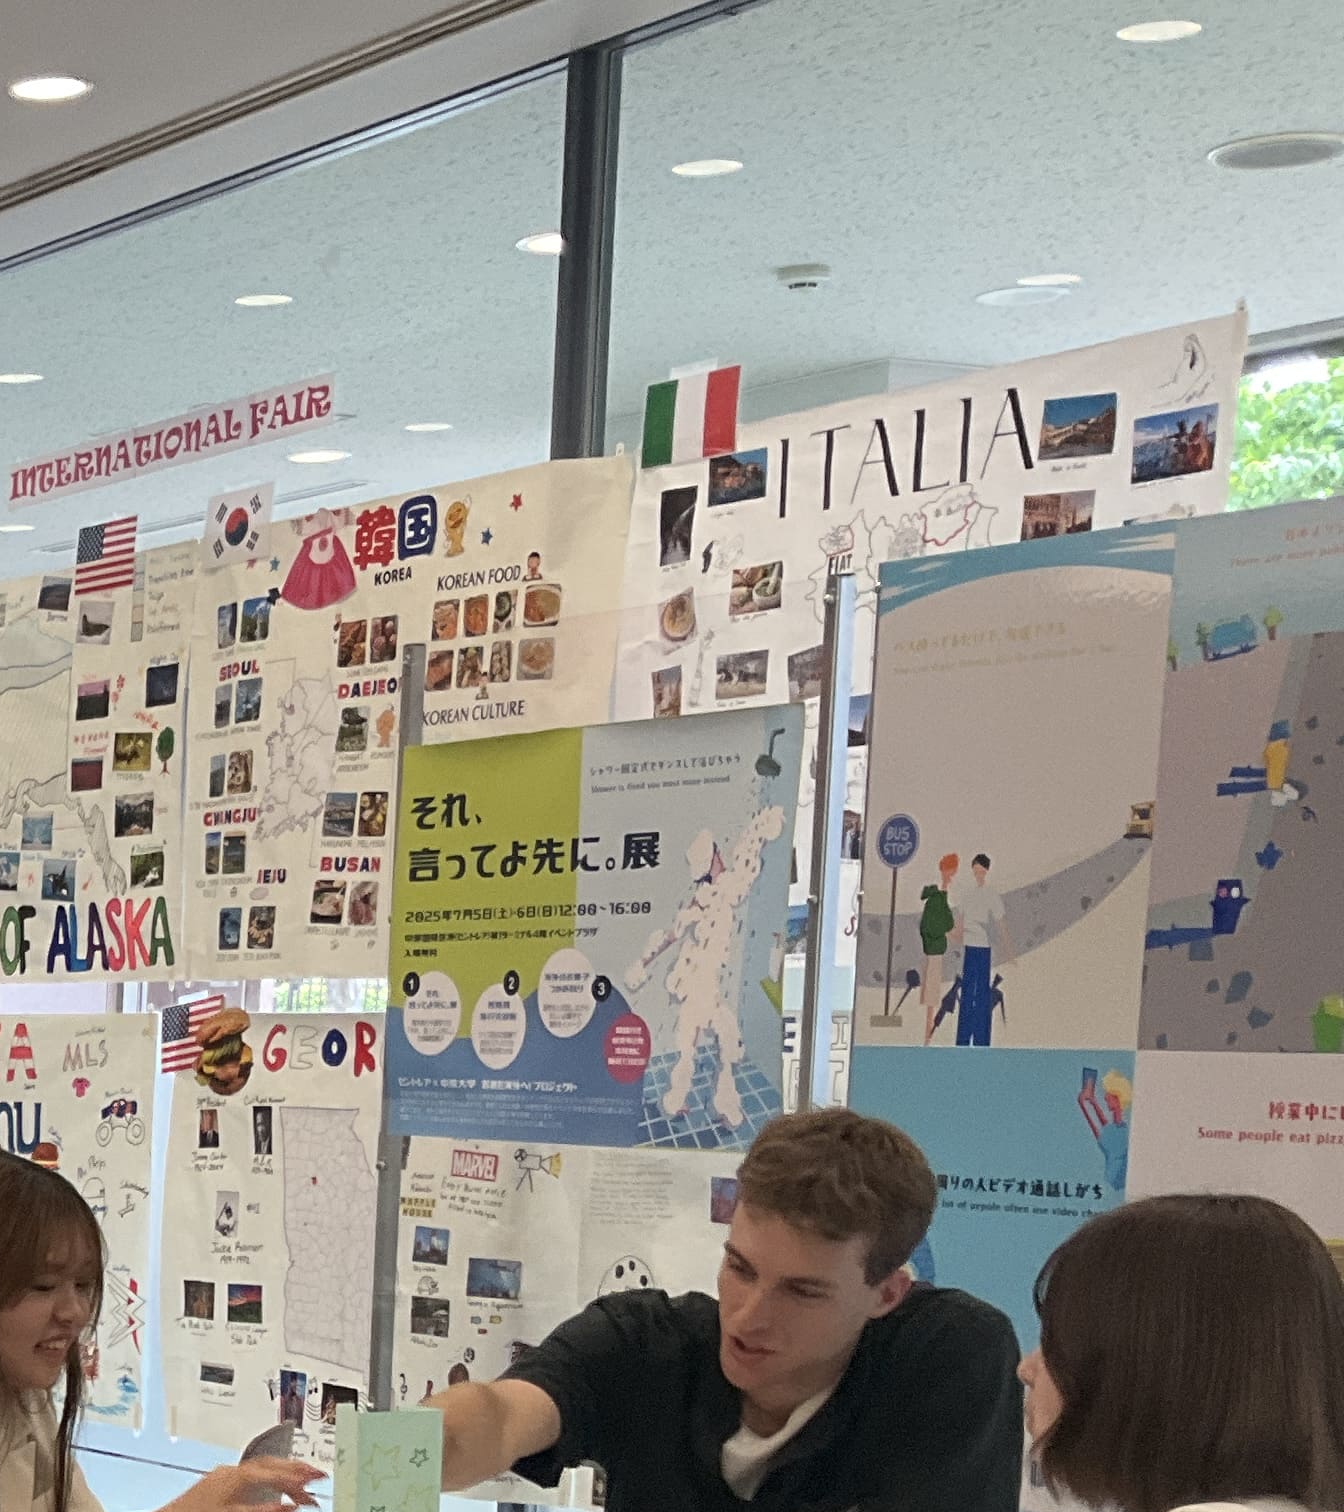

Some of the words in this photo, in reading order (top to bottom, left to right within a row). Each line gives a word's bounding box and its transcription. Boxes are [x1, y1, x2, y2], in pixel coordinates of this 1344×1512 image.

[9, 409, 242, 501] INTERNATIONAL
[249, 384, 332, 439] FAIR
[777, 387, 1034, 518] ITALIA
[353, 494, 438, 571] 韓国
[374, 566, 413, 586] KOREA
[436, 570, 486, 592] KOREAN
[487, 565, 521, 584] FOOD
[337, 678, 400, 699] DAEJEO
[422, 707, 470, 727] KOREAN
[471, 700, 526, 720] CULTURE
[410, 792, 483, 830] それ、
[885, 826, 911, 841] BUS
[407, 831, 661, 883] 言ってよ先に。展
[883, 841, 914, 857] STOP
[319, 856, 382, 873] BUSAN
[46, 896, 175, 973] ALASKA
[62, 1039, 109, 1072] MLS
[262, 1021, 384, 1078] GEOR
[1198, 1126, 1234, 1140] Some
[1237, 1128, 1284, 1143] people
[1288, 1131, 1311, 1144] eat
[1315, 1131, 1344, 1145] pizz
[452, 1151, 497, 1181] MARVEL
